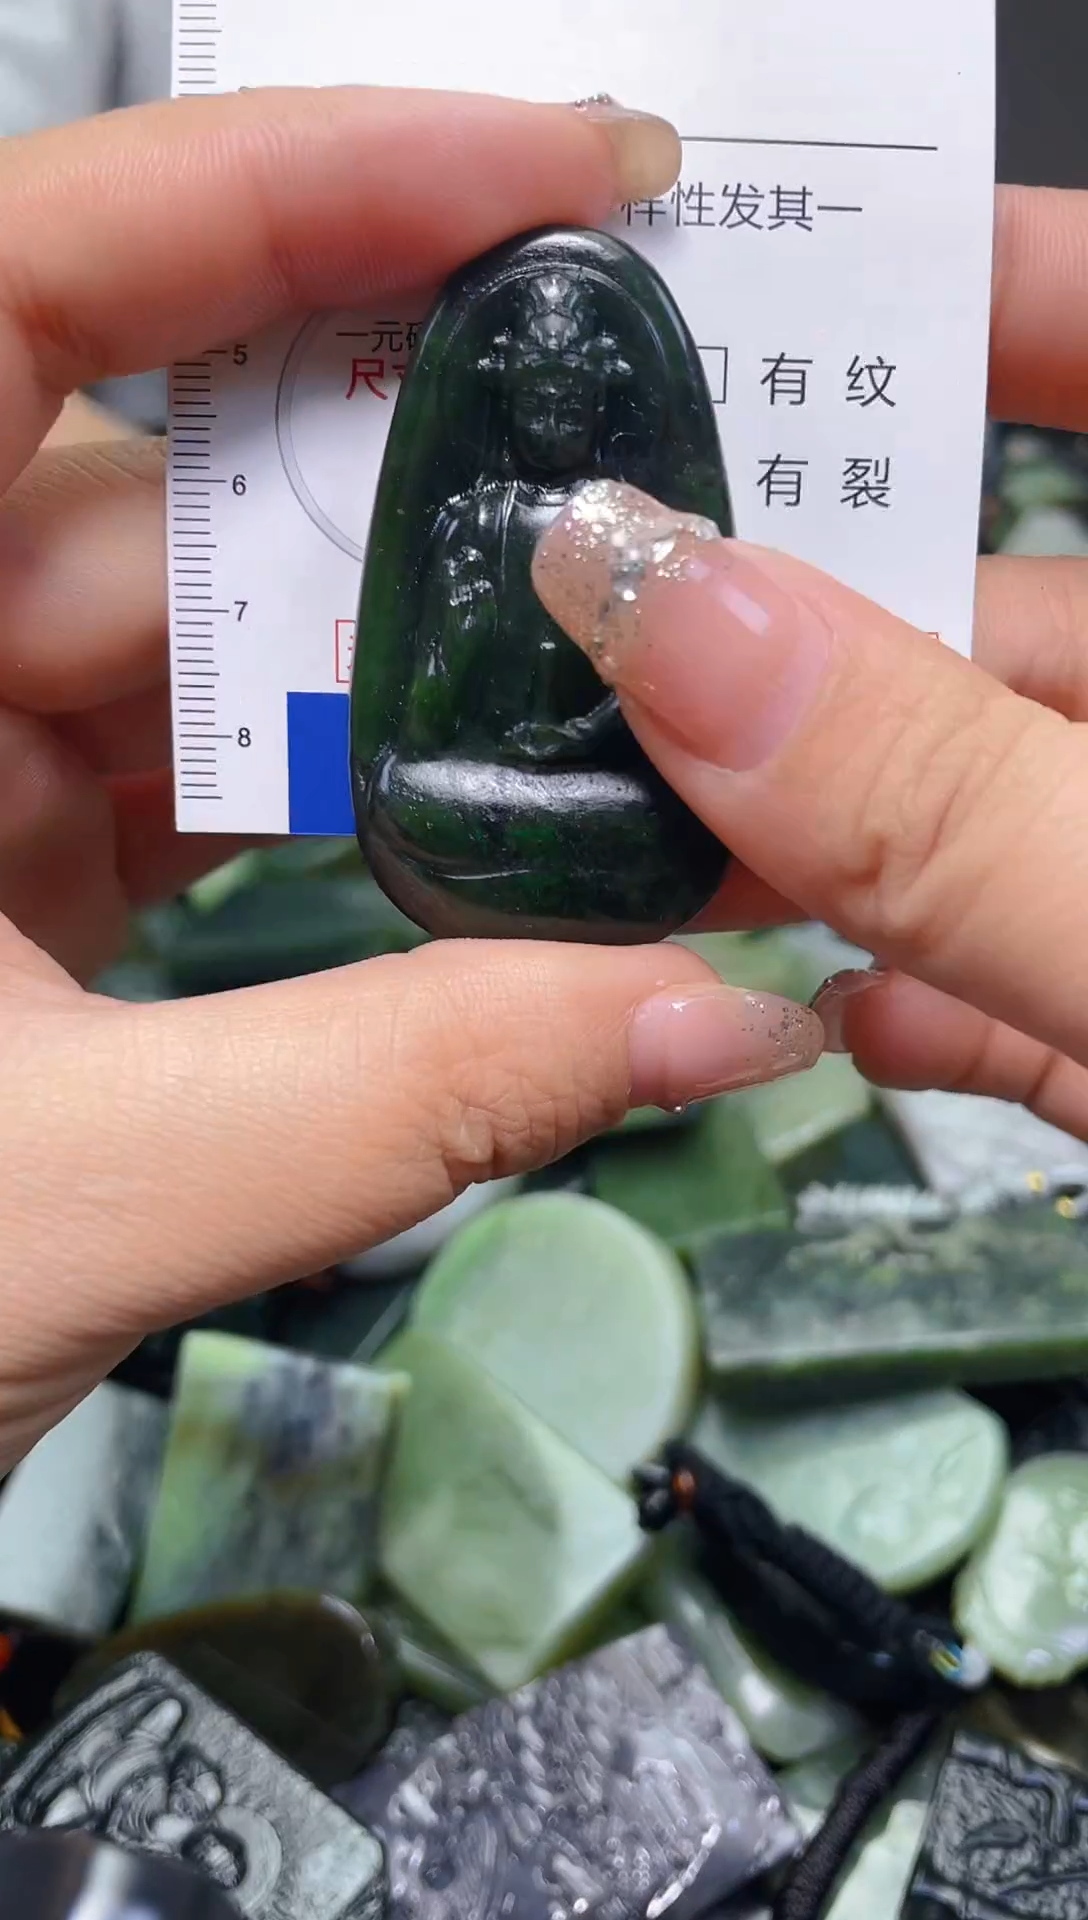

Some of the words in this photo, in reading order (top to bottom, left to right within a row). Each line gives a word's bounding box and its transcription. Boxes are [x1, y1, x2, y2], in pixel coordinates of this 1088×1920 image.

[232, 344, 248, 366] 5
[345, 358, 406, 400] 尺
[232, 474, 247, 496] 6
[234, 601, 249, 622] 7
[237, 727, 252, 748] 8
